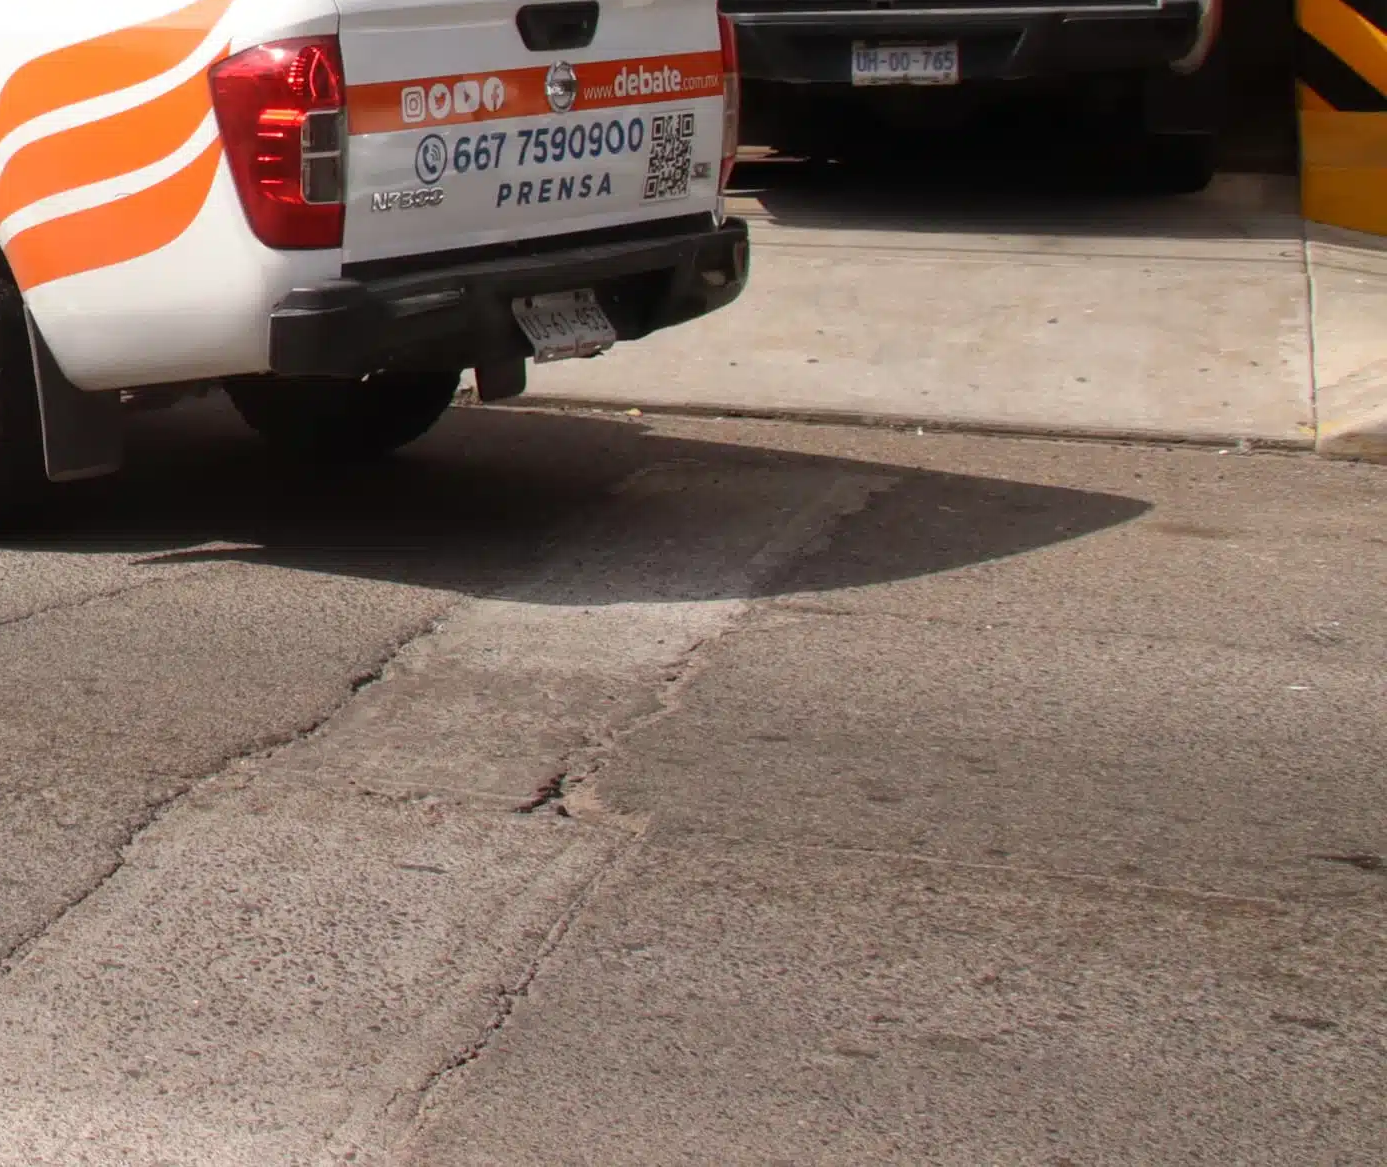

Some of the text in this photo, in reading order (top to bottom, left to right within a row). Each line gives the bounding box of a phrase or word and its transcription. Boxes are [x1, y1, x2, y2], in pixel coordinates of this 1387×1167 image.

[583, 64, 720, 100] www.debate.com.mx
[453, 118, 644, 174] 667 7590900
[496, 172, 611, 208] PRENSA
